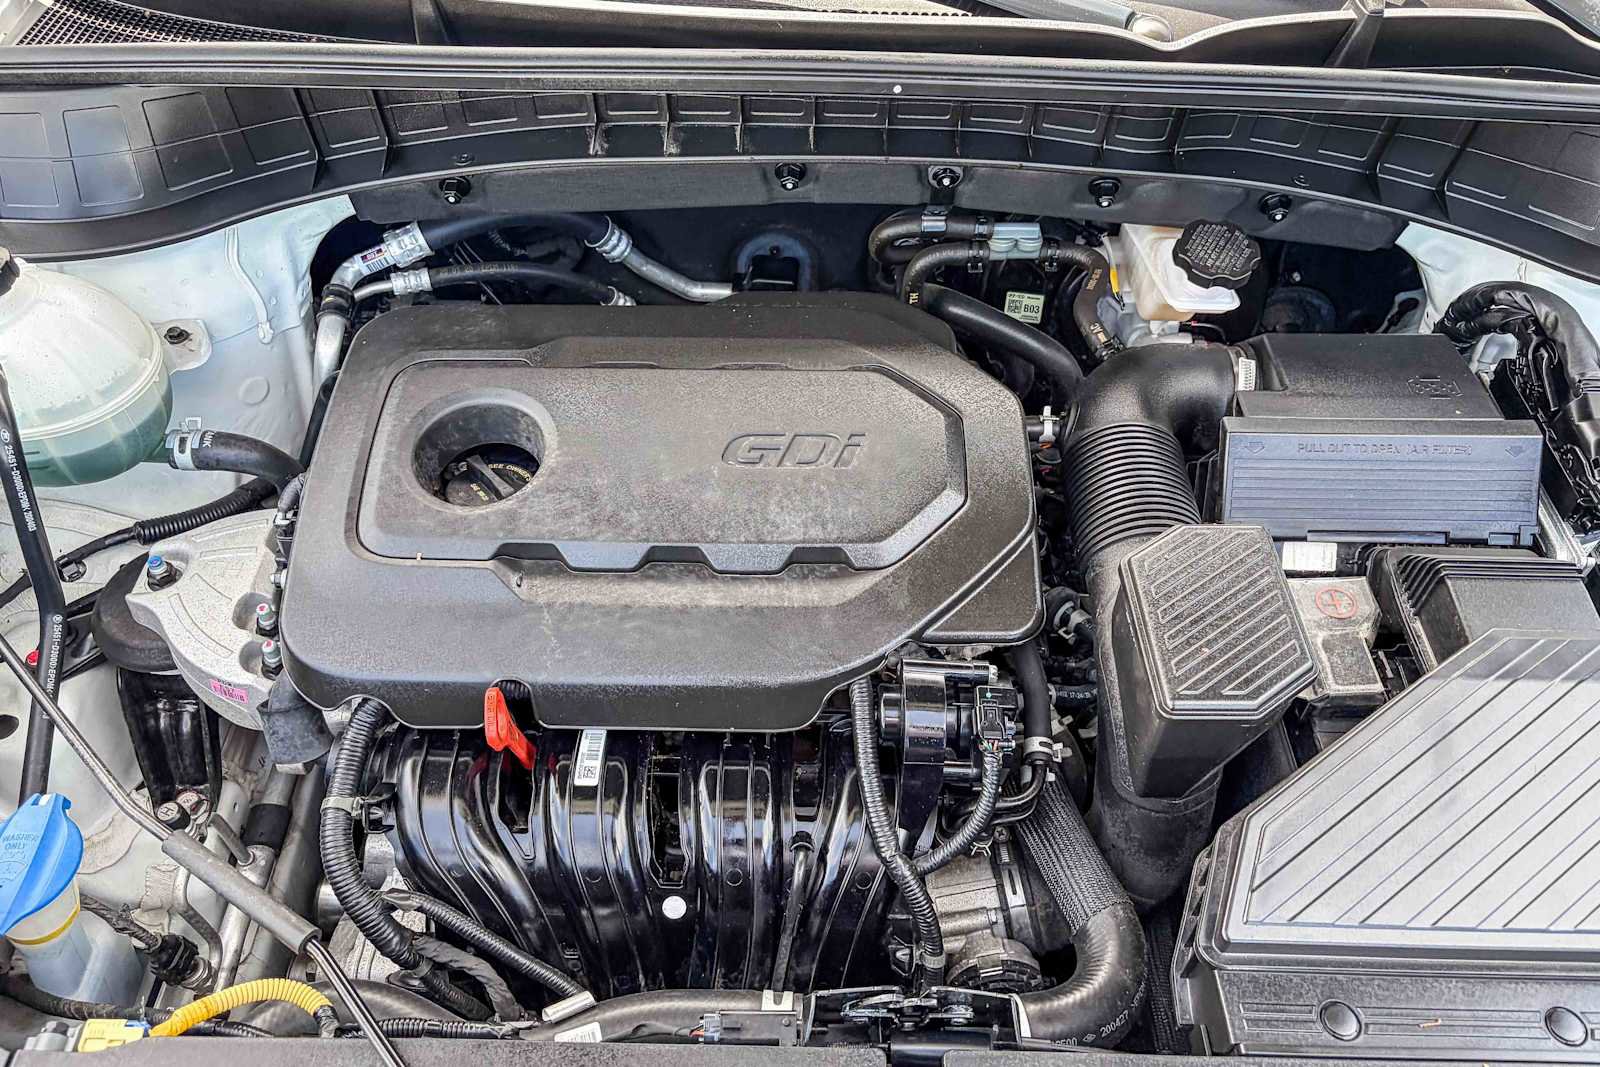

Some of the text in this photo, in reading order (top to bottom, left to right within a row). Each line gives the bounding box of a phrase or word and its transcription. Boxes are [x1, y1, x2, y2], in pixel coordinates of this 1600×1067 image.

[721, 433, 866, 469] GDi
[1298, 443, 1325, 453] PULL
[1328, 443, 1351, 453] OUT
[1099, 1009, 1129, 1038] 200427
